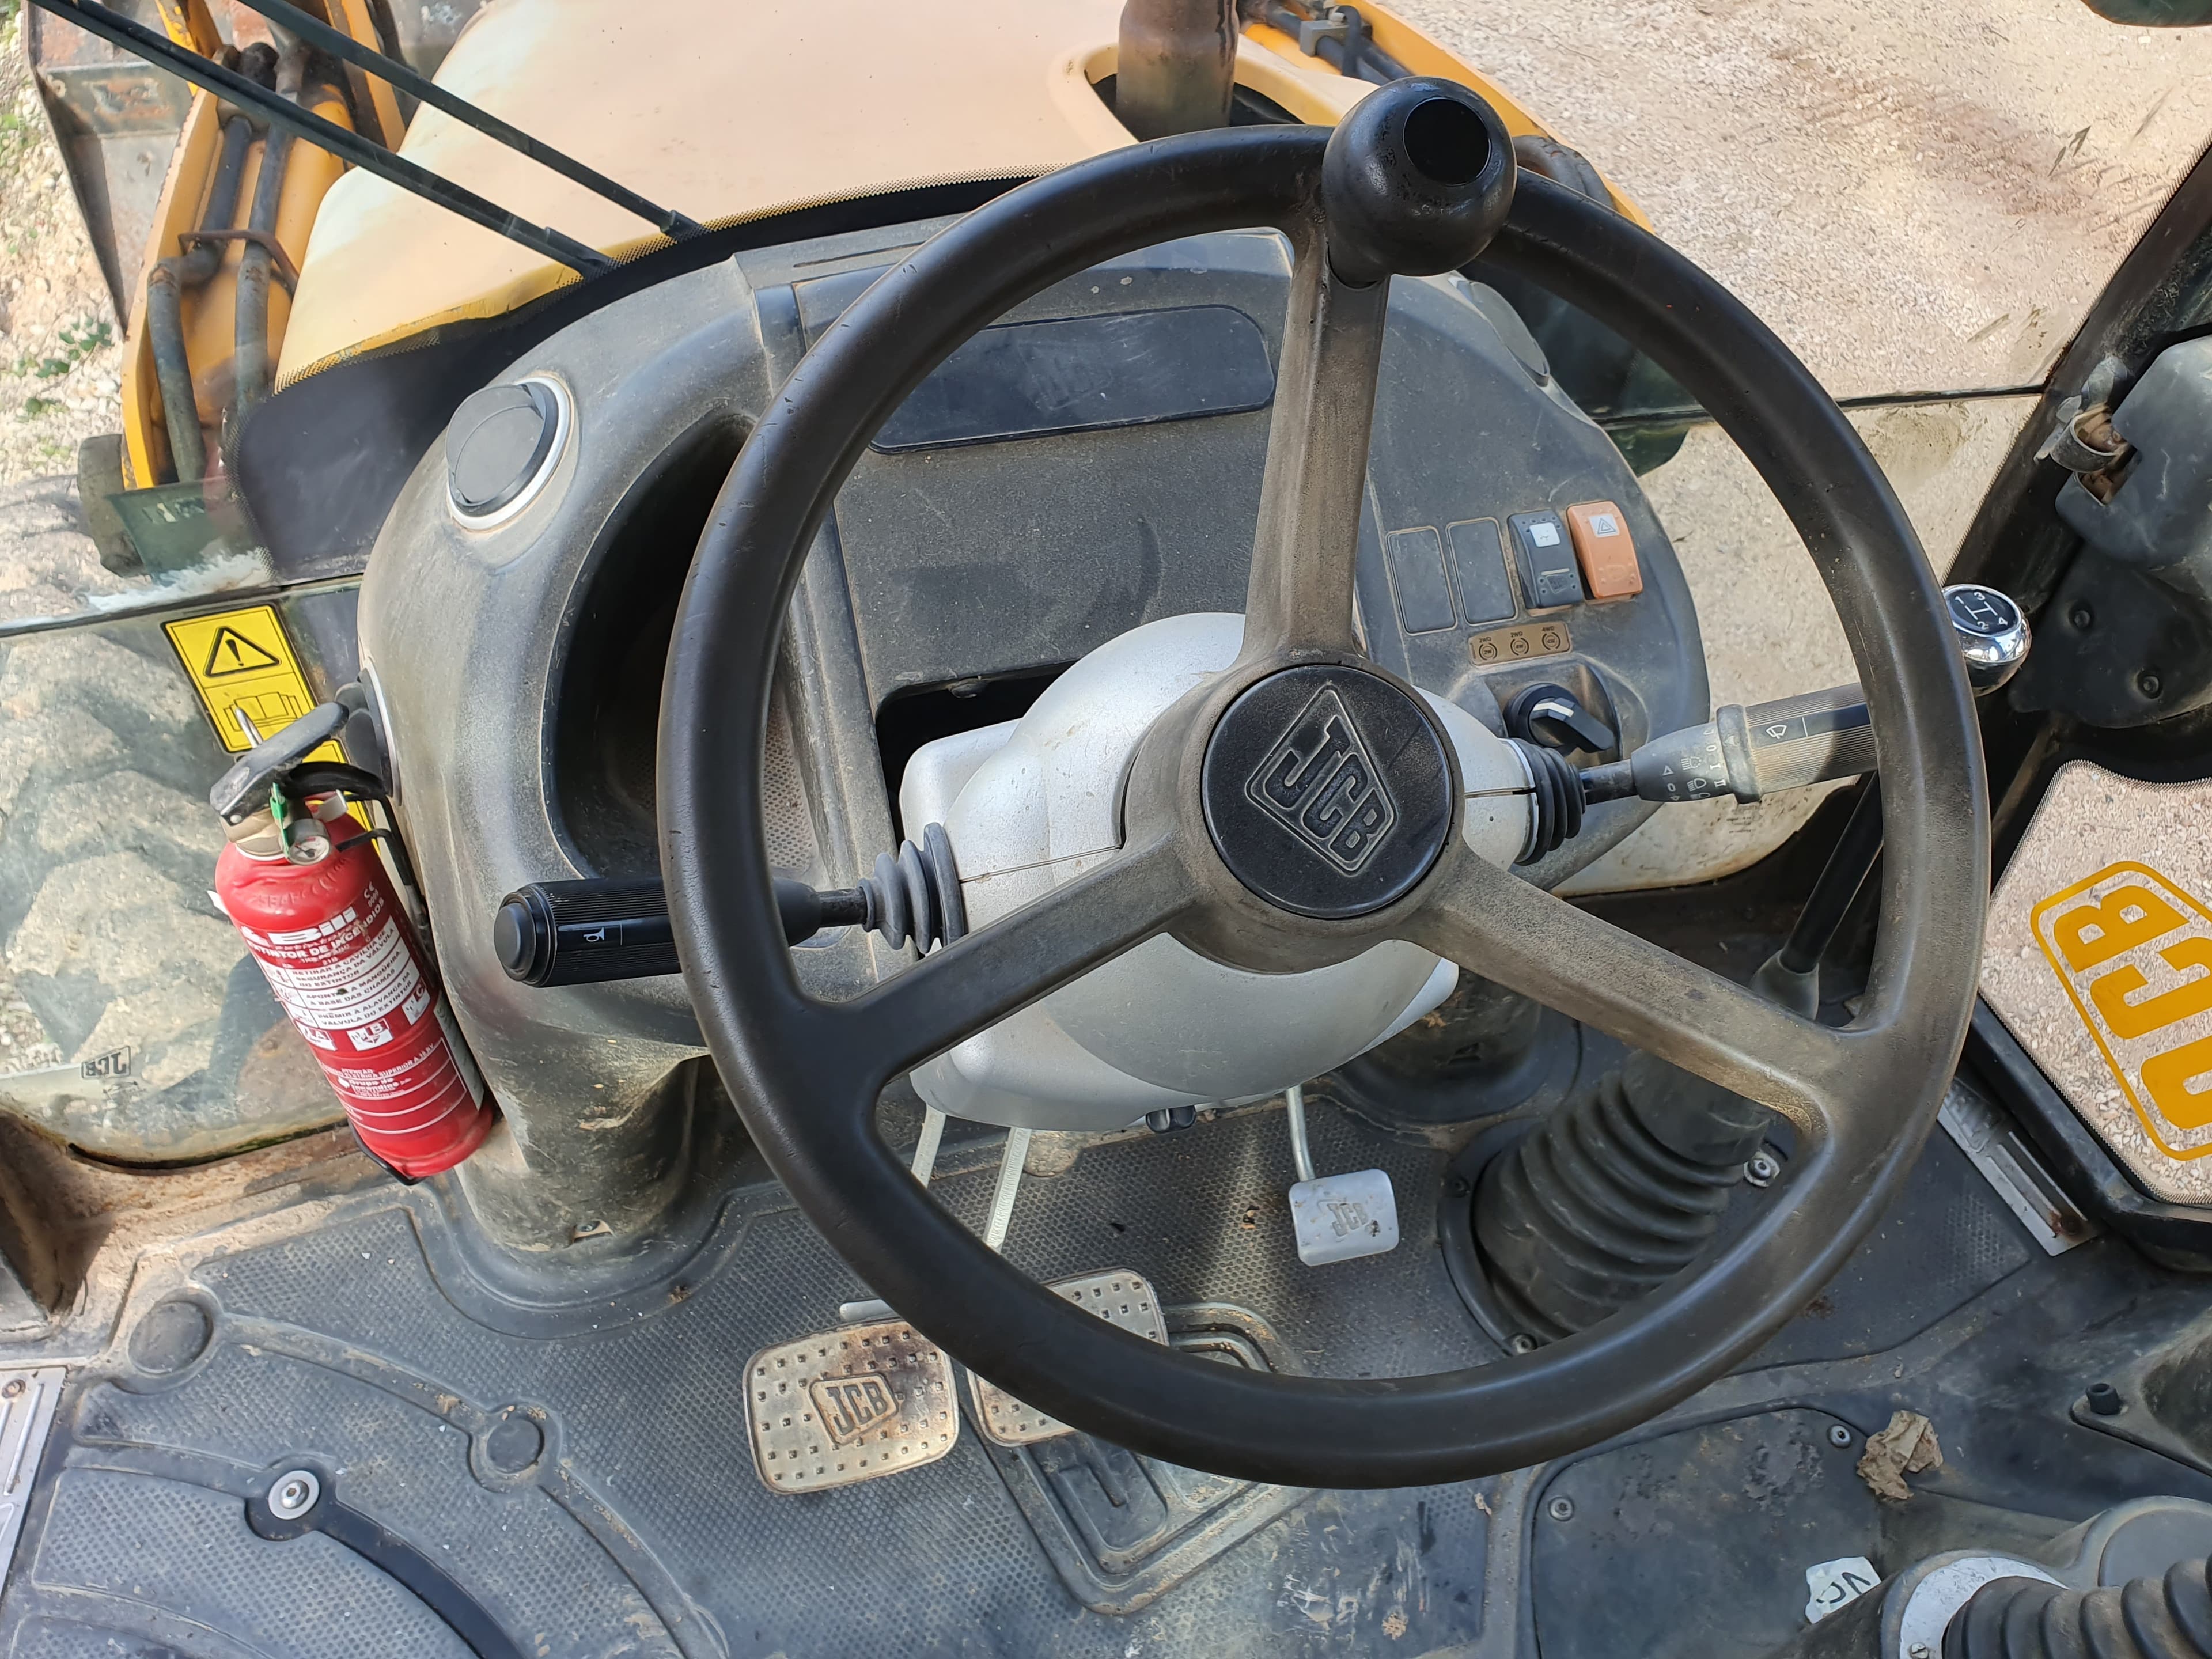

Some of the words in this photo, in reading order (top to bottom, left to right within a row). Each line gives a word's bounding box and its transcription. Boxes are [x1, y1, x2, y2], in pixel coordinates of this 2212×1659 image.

[1955, 596, 1965, 604] 1
[1974, 591, 1986, 600] 3
[1977, 621, 1989, 630] 2
[1998, 616, 2008, 626] 4
[1263, 714, 1386, 863] JCB
[309, 944, 328, 957] DE
[353, 959, 366, 968] DA
[314, 969, 360, 987] EXTINTOR
[364, 1010, 377, 1020] DO
[372, 1022, 384, 1035] B
[1327, 1202, 1369, 1237] JCB
[825, 1382, 888, 1437] JCB
